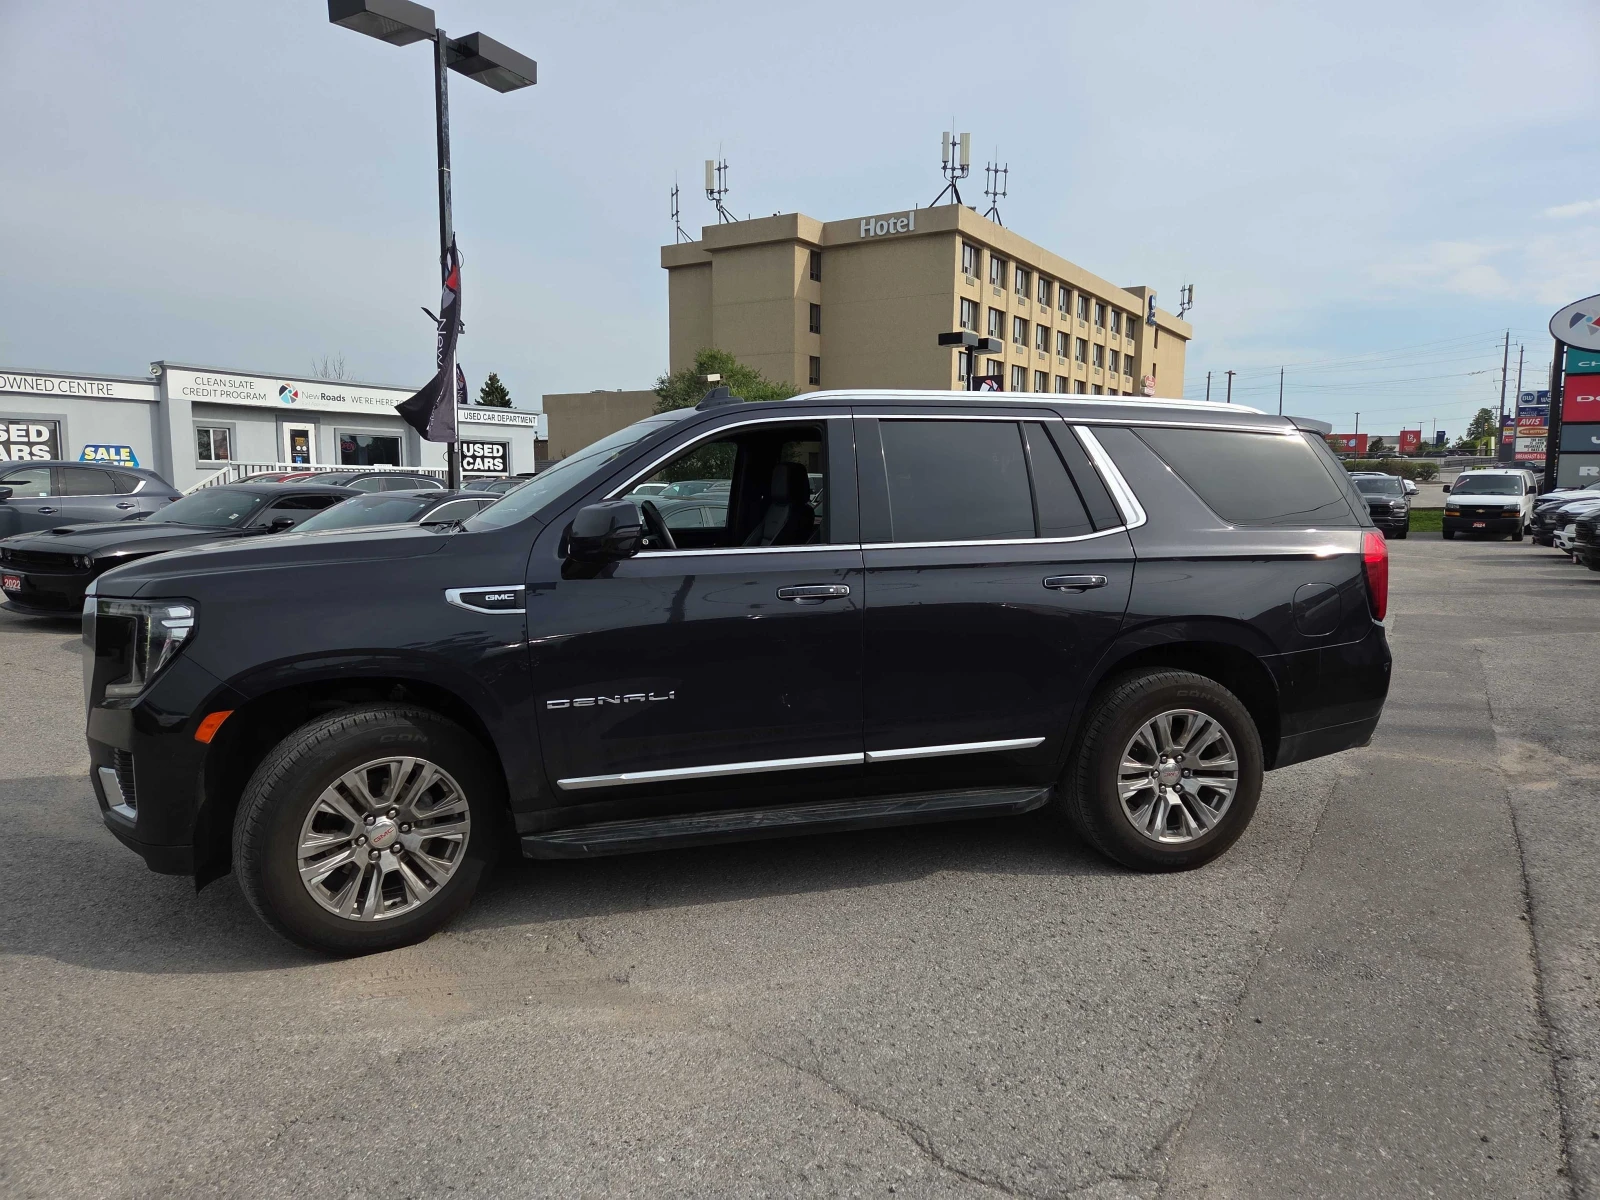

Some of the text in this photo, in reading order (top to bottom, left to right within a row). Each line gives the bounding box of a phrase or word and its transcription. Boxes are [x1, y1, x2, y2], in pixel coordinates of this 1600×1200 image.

[860, 211, 915, 238] Hotel
[58, 380, 114, 396] CENTRE
[194, 376, 255, 390] CLEAN SLATE
[182, 387, 267, 401] CREDIT PROGRAM
[375, 397, 394, 407] HERE
[463, 412, 536, 424] USED CAR DEPARTMENT
[84, 447, 131, 460] SALE
[462, 443, 503, 457] USED
[462, 457, 504, 471] CARS
[4, 578, 21, 590] 2022
[485, 593, 515, 601] GMC
[546, 690, 675, 710] DENALI
[373, 826, 395, 843] GMC
